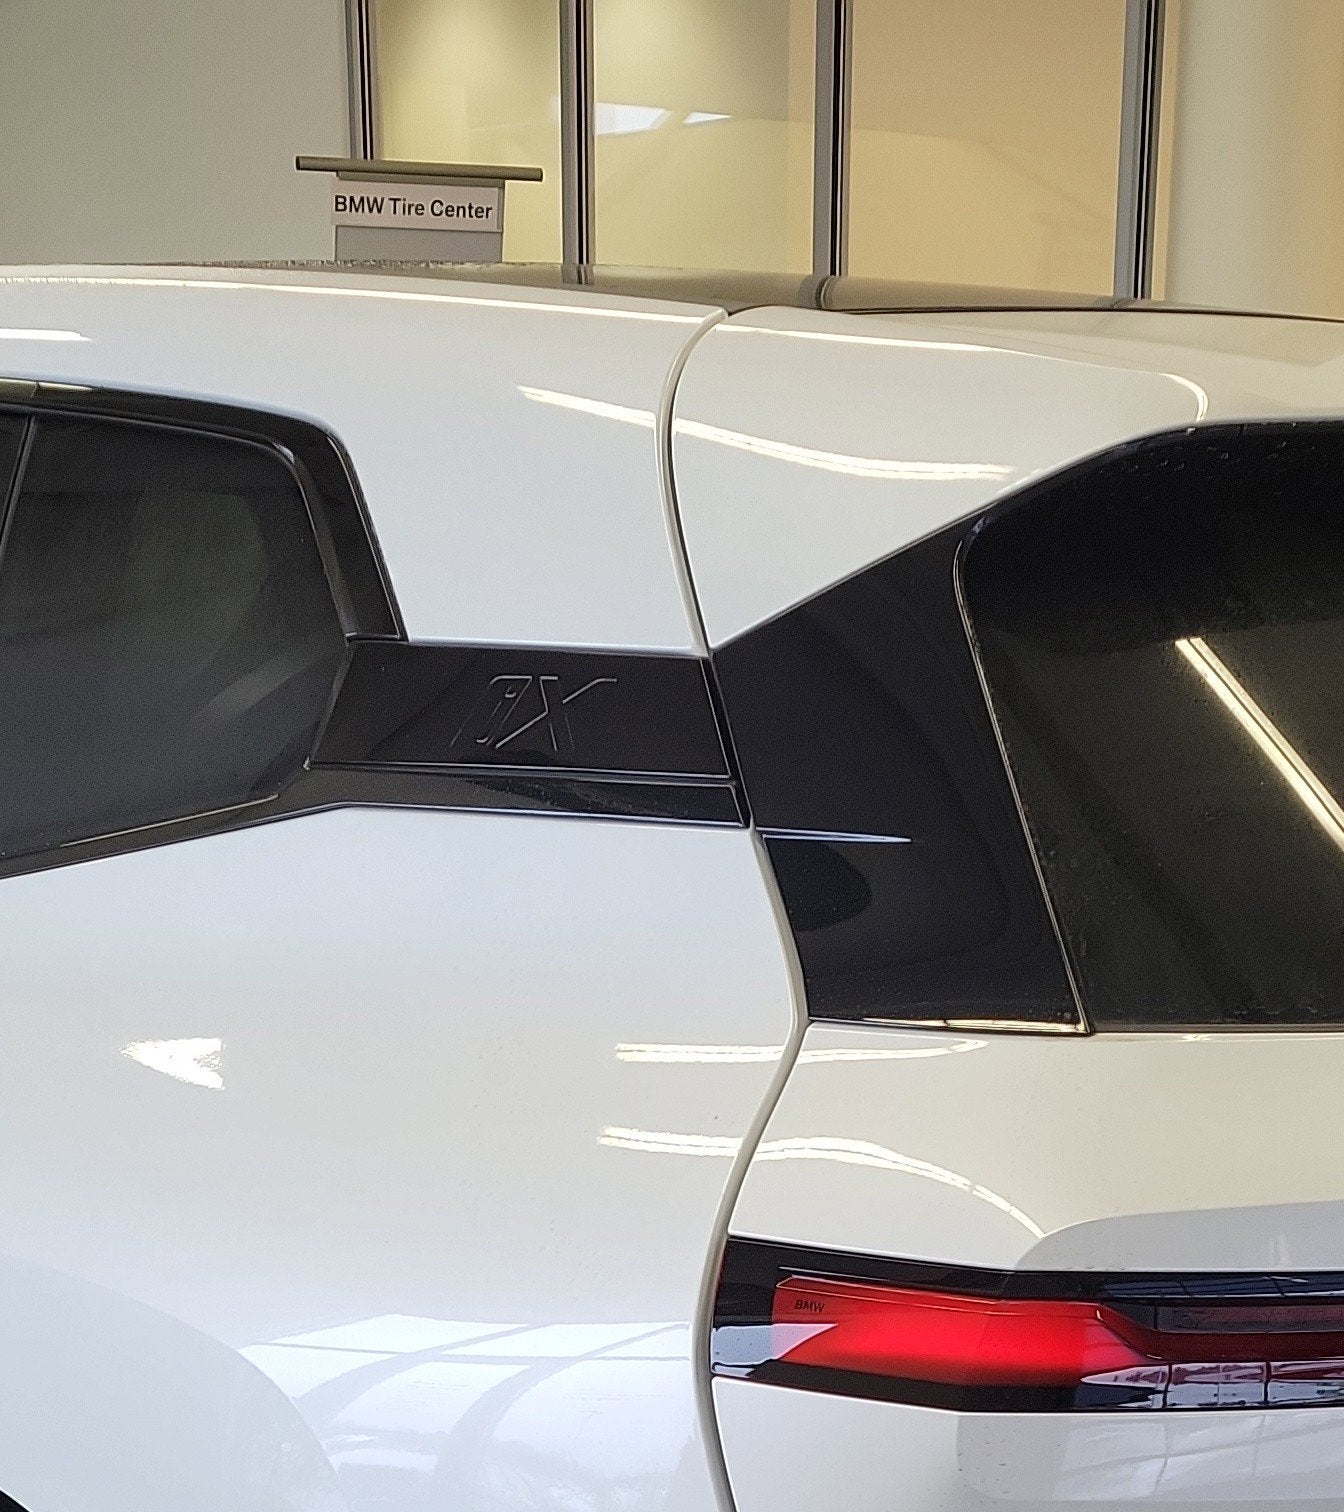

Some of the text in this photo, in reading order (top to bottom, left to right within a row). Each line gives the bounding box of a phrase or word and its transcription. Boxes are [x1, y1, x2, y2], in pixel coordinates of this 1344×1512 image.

[334, 194, 493, 219] BMW Tire Center
[795, 1299, 825, 1313] BMW
